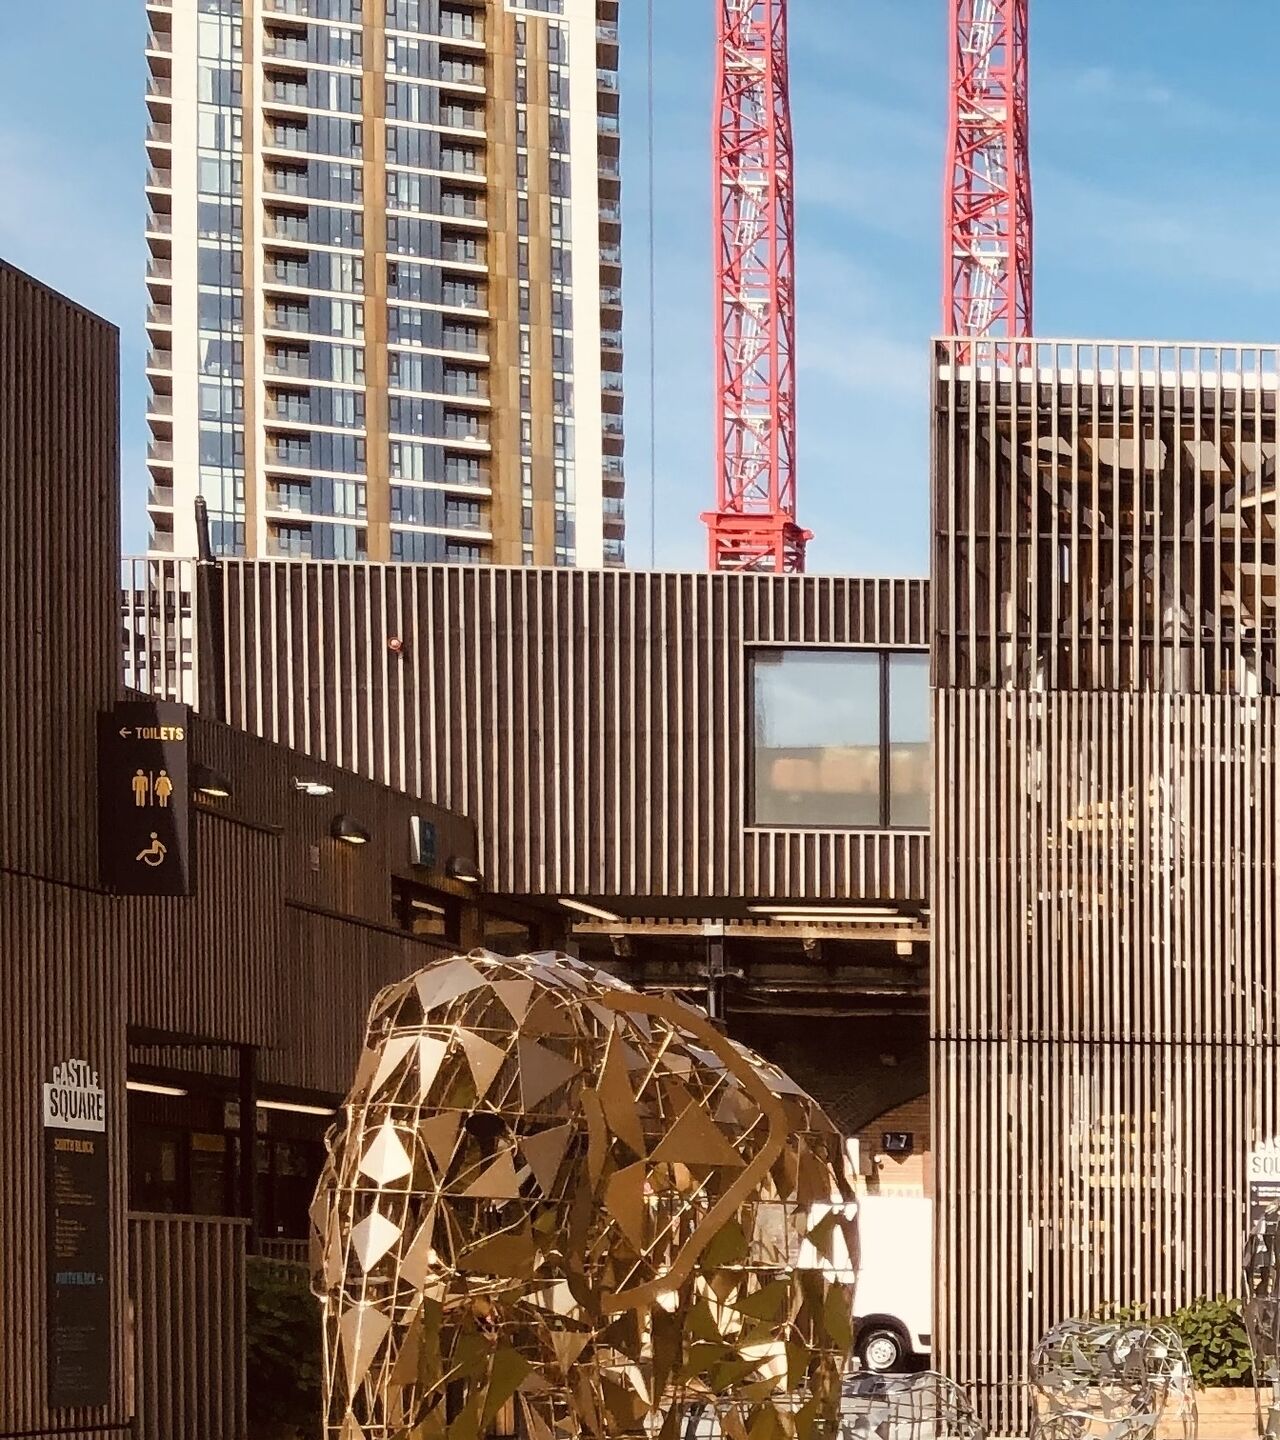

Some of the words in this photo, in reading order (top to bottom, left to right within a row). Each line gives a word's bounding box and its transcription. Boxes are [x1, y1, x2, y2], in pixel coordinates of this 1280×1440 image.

[135, 727, 184, 741] TOILETS
[53, 1058, 99, 1090] CASTLE
[50, 1088, 104, 1122] SQUARE
